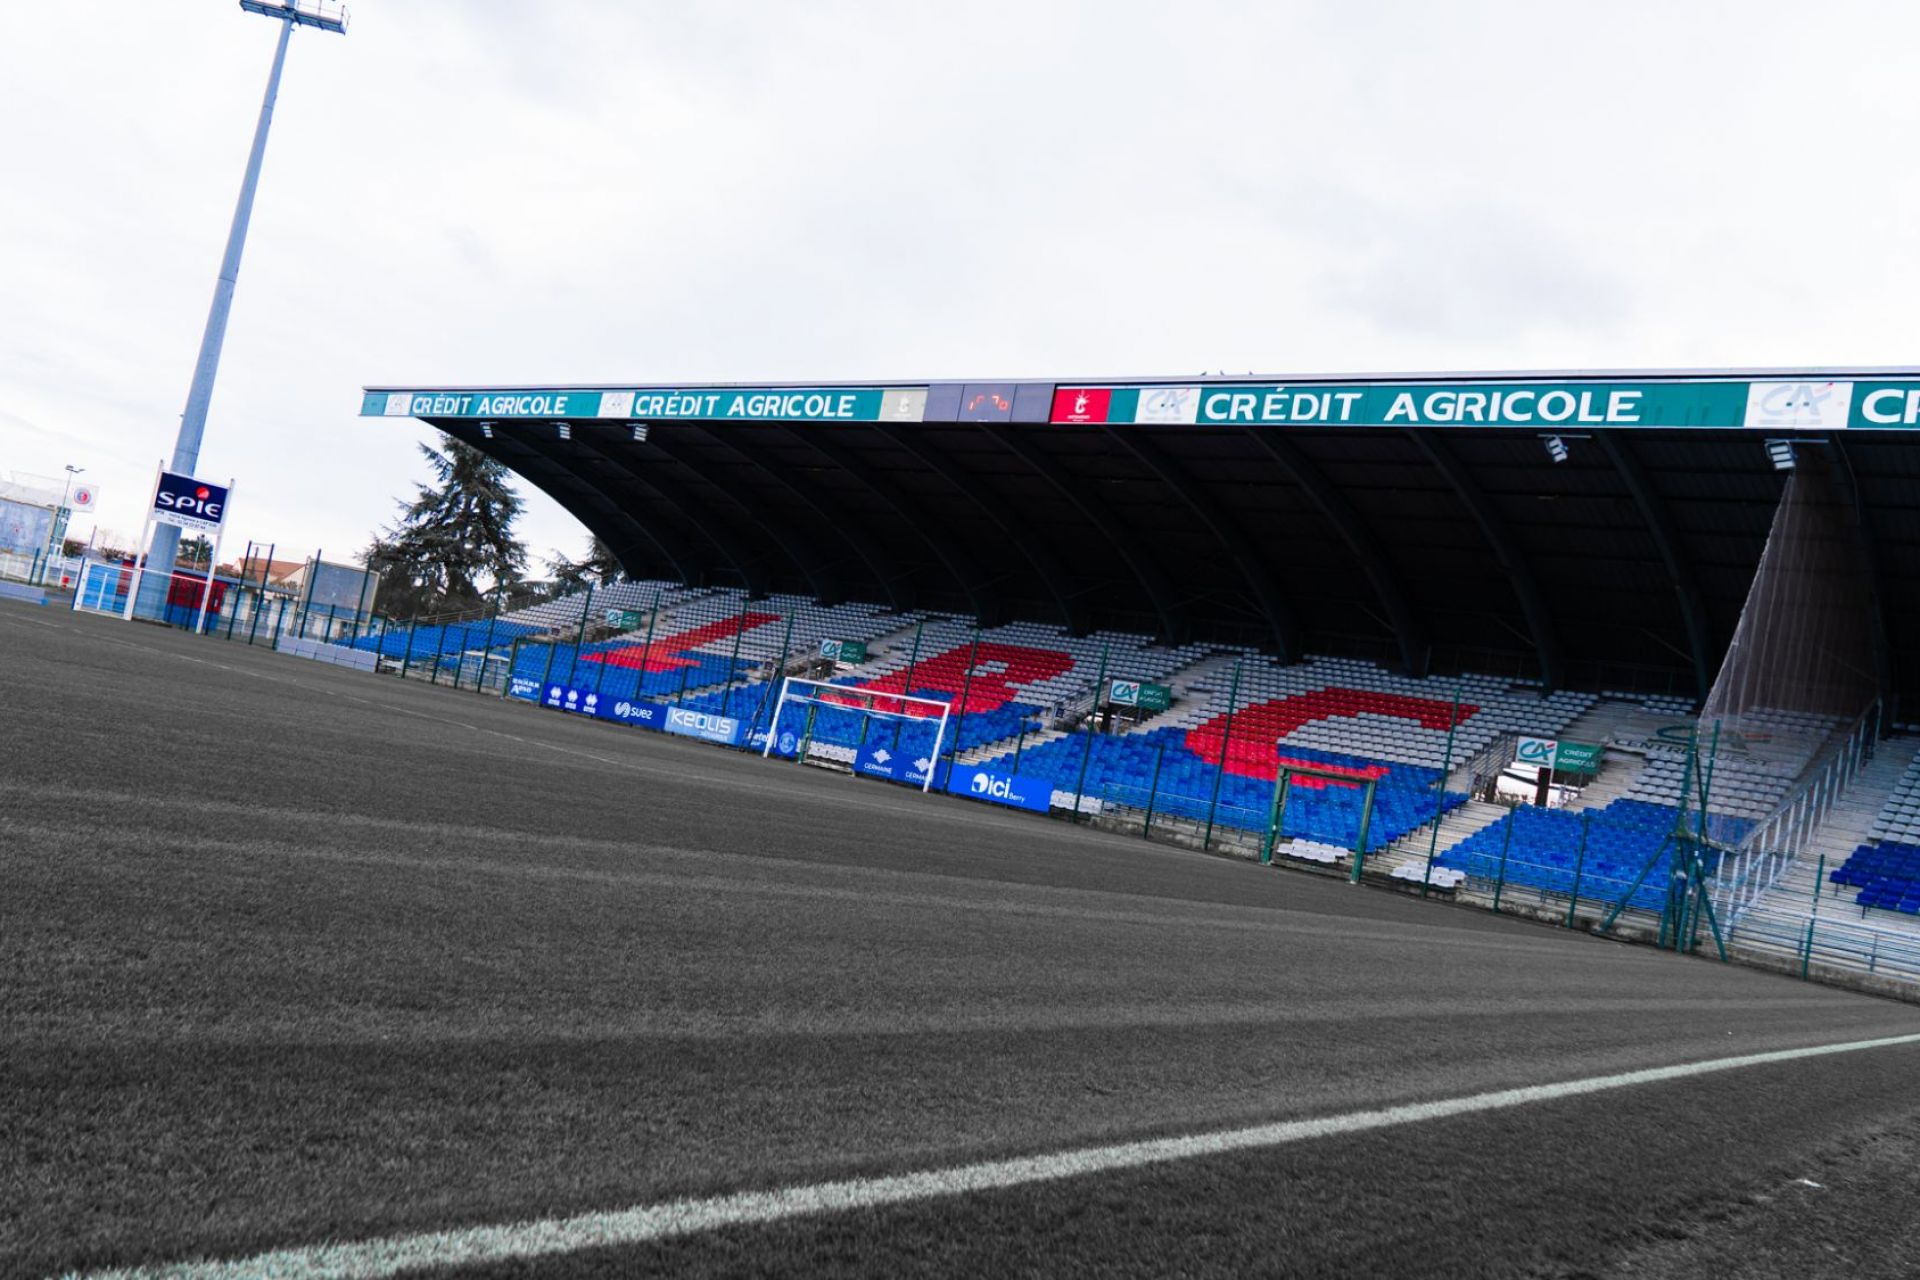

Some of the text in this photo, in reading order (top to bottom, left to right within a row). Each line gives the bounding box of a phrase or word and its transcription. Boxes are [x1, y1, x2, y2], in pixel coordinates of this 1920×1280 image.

[412, 394, 568, 415] CRÉDIT AGRICOLE
[635, 392, 857, 417] CRÉDIT AGRICOLE
[1205, 387, 1643, 422] CRÉDIT AGRICOLE
[988, 774, 1012, 799] ici
